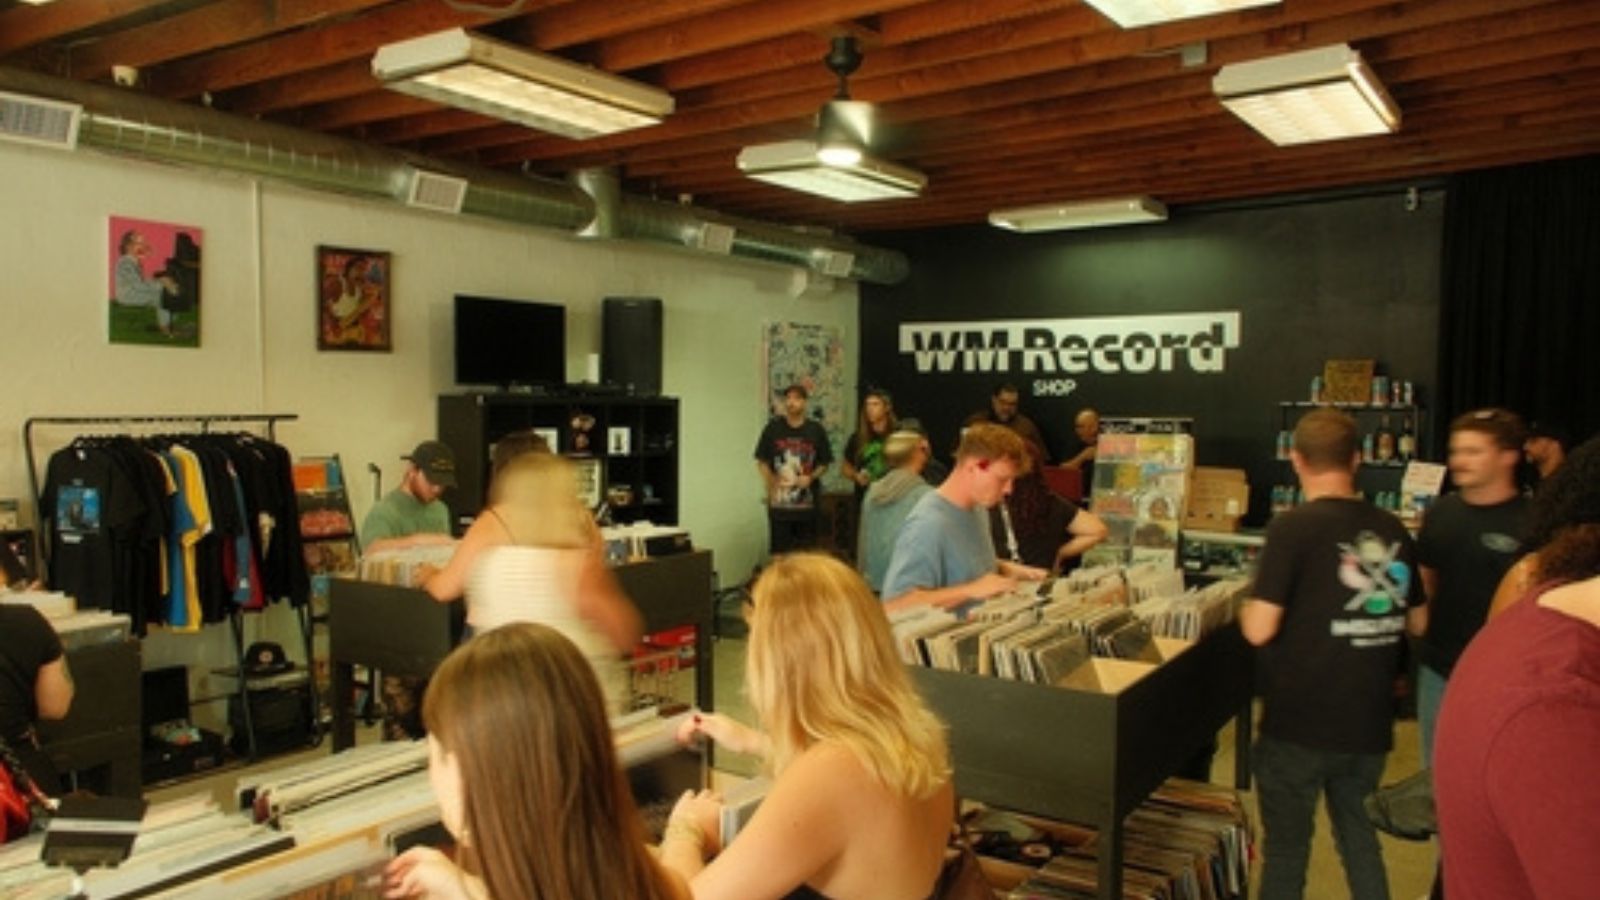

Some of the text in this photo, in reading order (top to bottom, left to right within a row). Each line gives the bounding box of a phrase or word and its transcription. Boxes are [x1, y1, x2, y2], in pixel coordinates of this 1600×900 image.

[912, 322, 1225, 373] WM Record
[1032, 379, 1076, 397] SHOP
